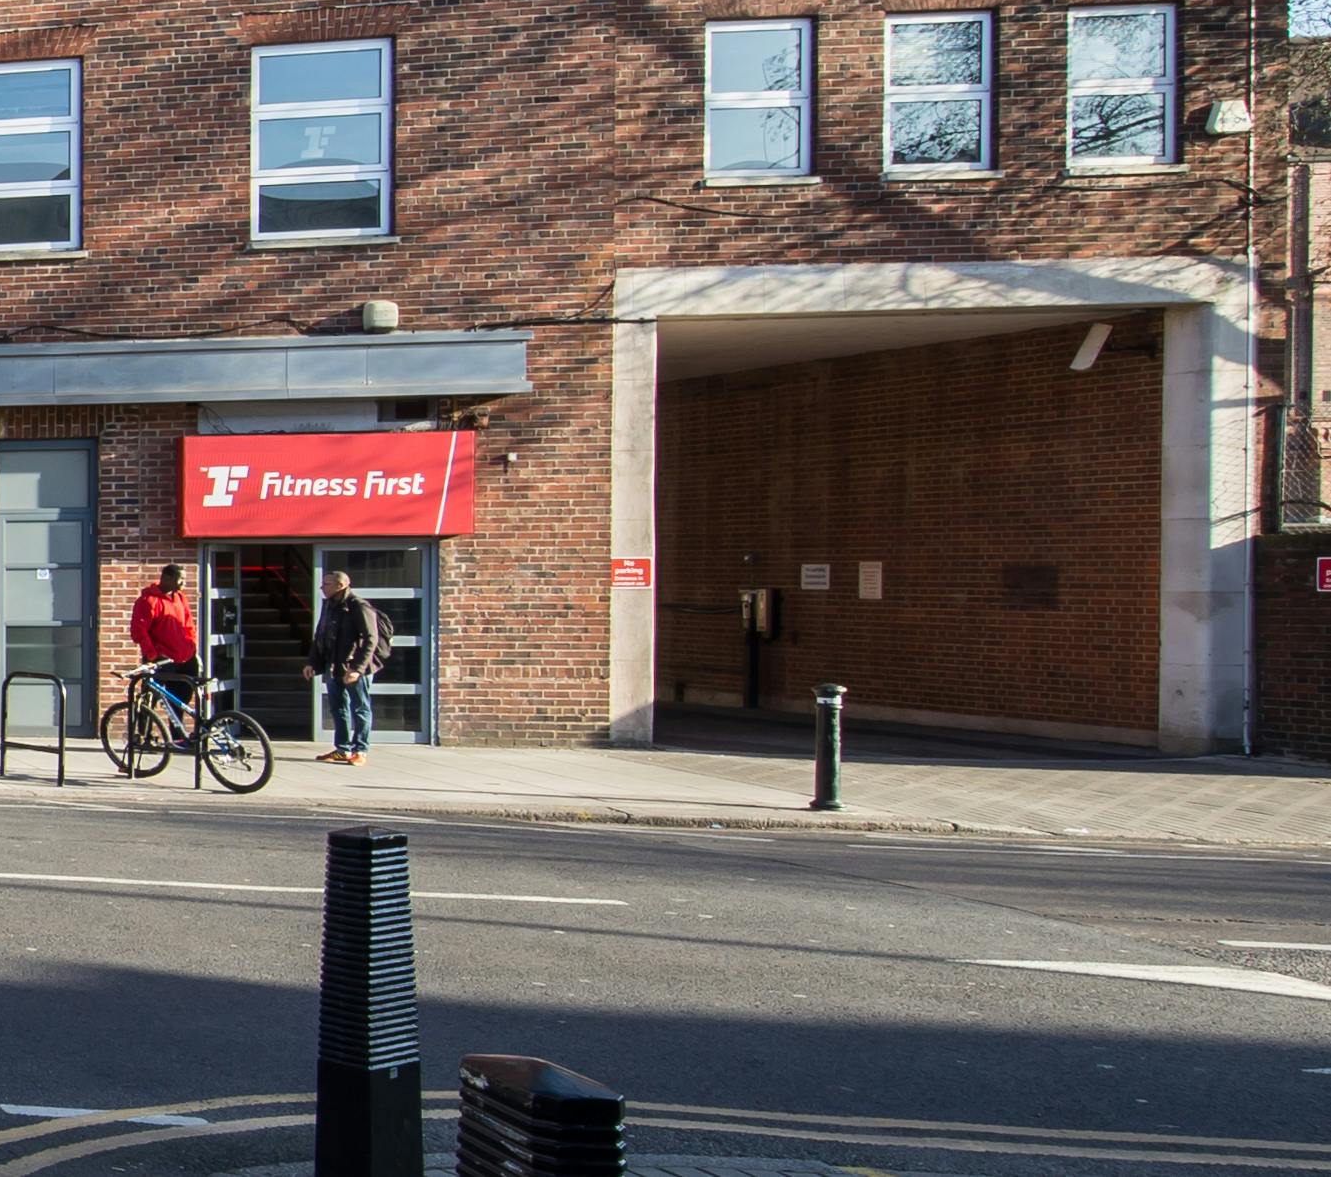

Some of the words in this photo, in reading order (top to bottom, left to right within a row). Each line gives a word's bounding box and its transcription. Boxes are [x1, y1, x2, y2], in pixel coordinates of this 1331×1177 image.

[260, 471, 358, 500] Fitness
[363, 470, 425, 499] First
[623, 559, 635, 567] No
[614, 567, 644, 576] parking
